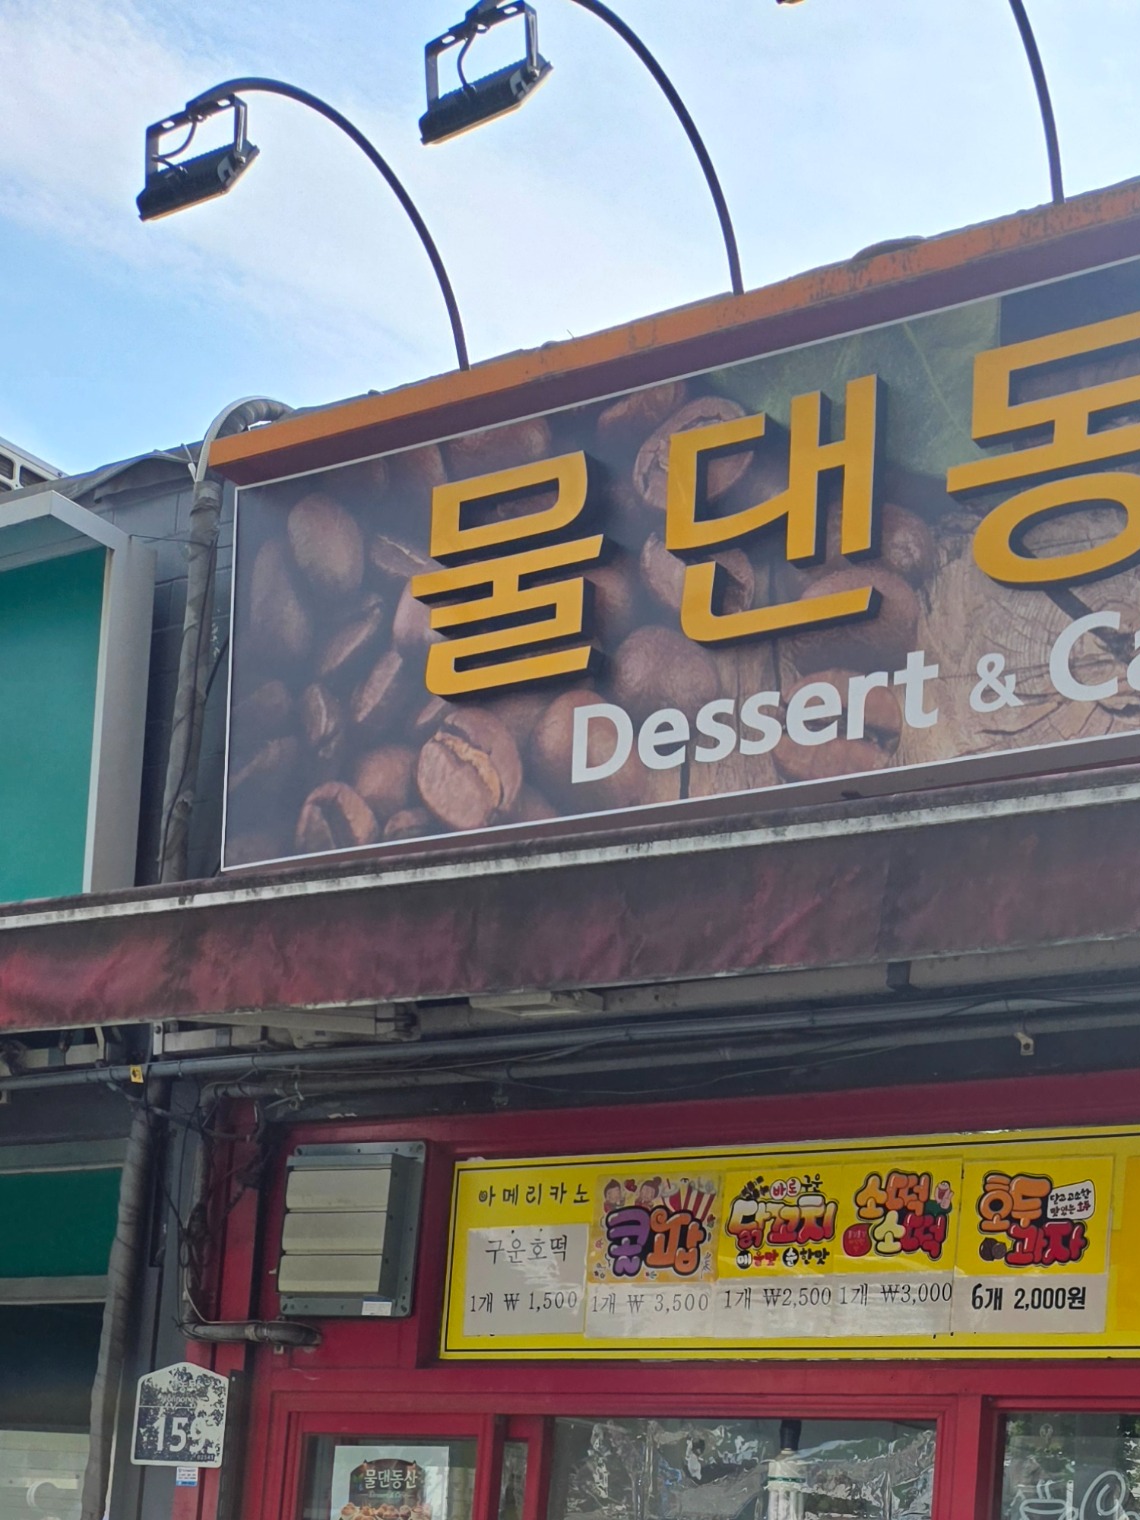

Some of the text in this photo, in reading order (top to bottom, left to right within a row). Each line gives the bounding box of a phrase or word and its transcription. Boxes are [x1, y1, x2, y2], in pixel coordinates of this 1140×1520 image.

[571, 650, 938, 784] Dessert
[969, 656, 1020, 713] &
[478, 1182, 590, 1207] 아메리카노
[769, 1178, 800, 1200] 바로
[855, 1170, 931, 1219] 소떡
[977, 1170, 1053, 1234] 호두
[727, 1193, 838, 1249] 닭꼬치
[873, 1210, 948, 1260] 소떡
[485, 1235, 568, 1264] 구운호떡
[605, 1205, 706, 1277] 콜팝
[1003, 1219, 1089, 1267] 과자
[782, 1247, 830, 1268] 순한맛
[470, 1292, 493, 1313] 1개
[528, 1291, 578, 1312] 1,500
[592, 1293, 616, 1314] 1개
[654, 1293, 709, 1314] 3,500
[724, 1287, 751, 1310] 1개
[840, 1283, 868, 1307] 1개
[972, 1283, 1086, 1311] 6개 2,000원
[364, 1469, 418, 1489] 물댄동산
